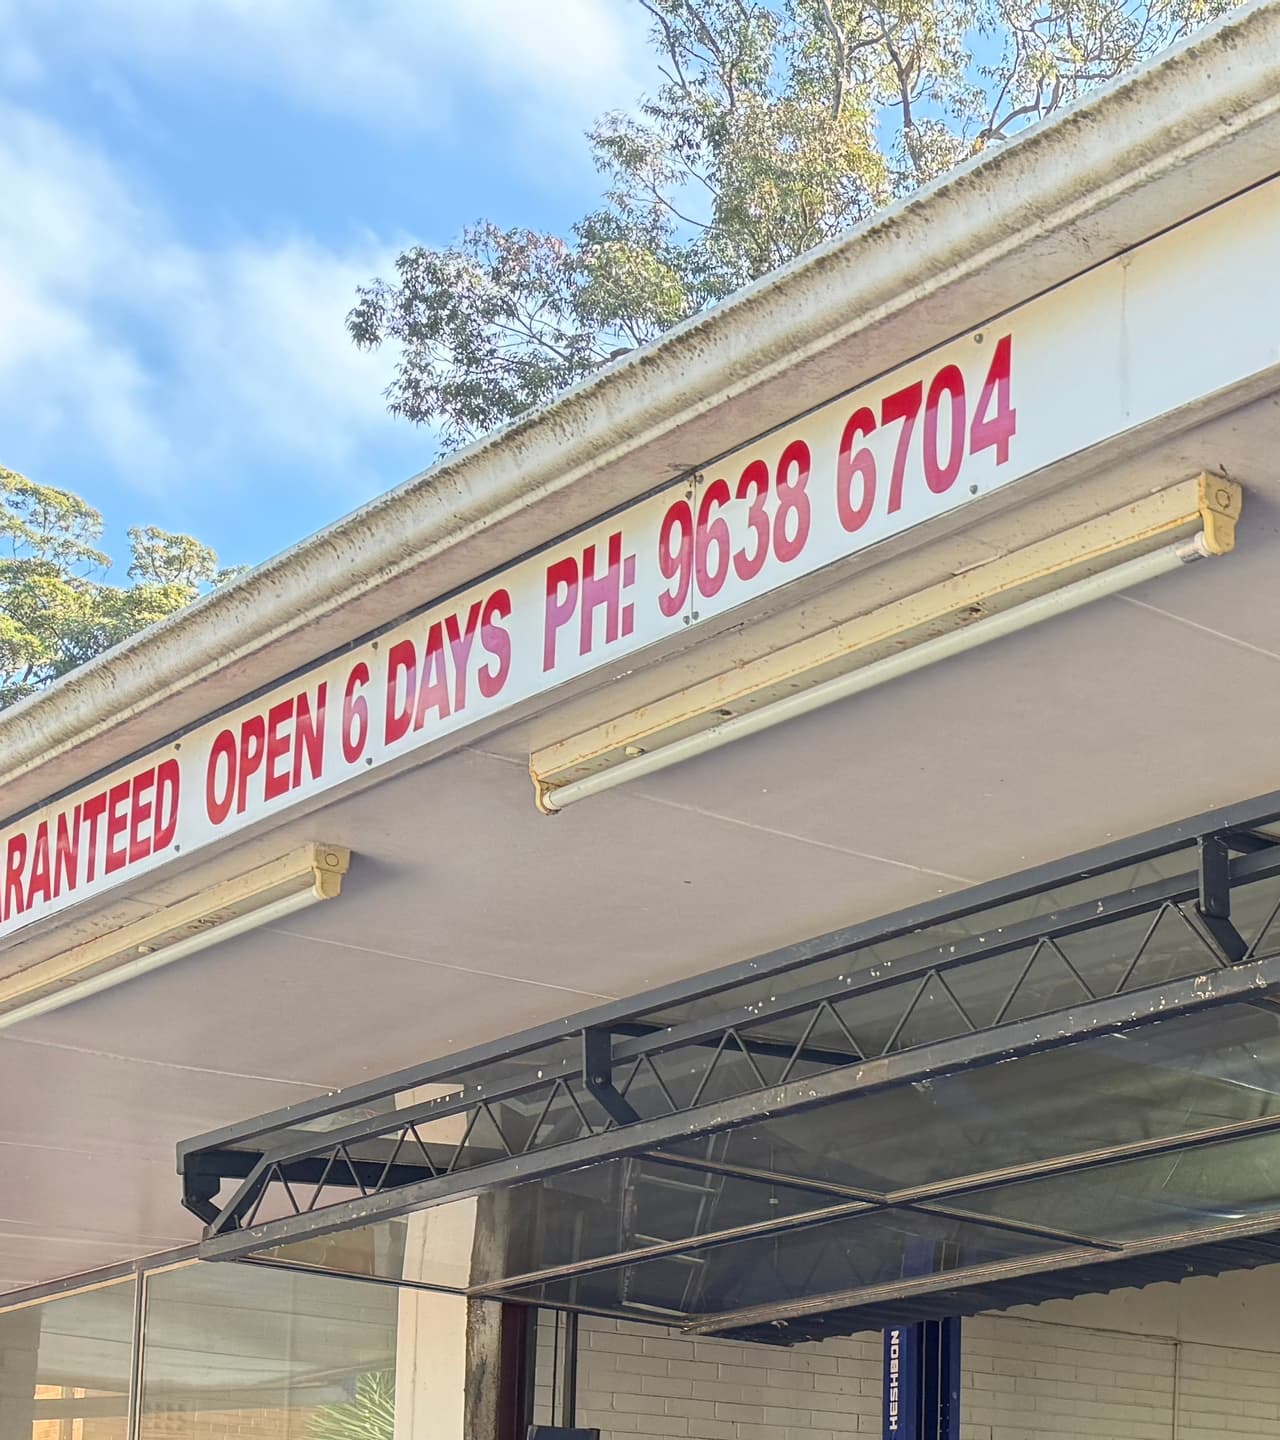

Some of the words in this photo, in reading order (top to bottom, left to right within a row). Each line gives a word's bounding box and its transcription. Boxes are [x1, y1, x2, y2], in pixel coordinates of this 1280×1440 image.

[0, 758, 181, 922] RANTEED
[206, 683, 328, 825] OPEN
[342, 662, 370, 764] 6
[385, 588, 512, 745] DAYS
[542, 531, 635, 672] PH:
[658, 439, 812, 618] 9638
[837, 335, 1017, 533] 6704
[889, 1330, 900, 1431] HESHBON
